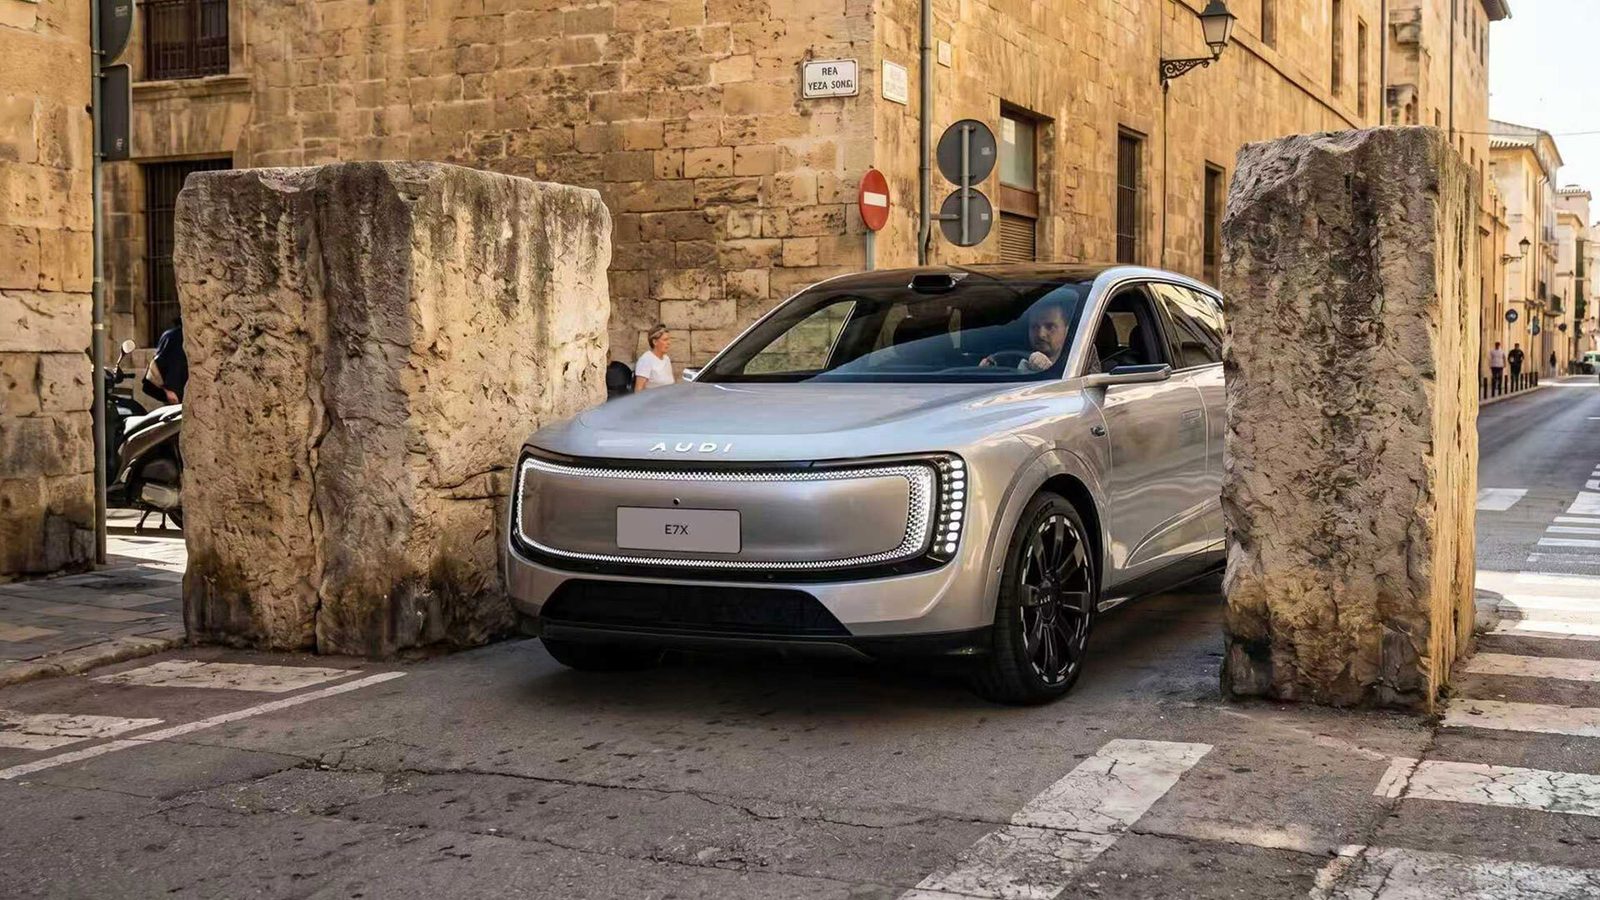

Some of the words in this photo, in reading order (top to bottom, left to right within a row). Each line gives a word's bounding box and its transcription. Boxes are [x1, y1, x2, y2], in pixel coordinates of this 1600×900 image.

[821, 66, 838, 76] REA
[808, 81, 828, 90] YEZA
[649, 442, 733, 453] AUDI
[664, 524, 689, 535] E7X
